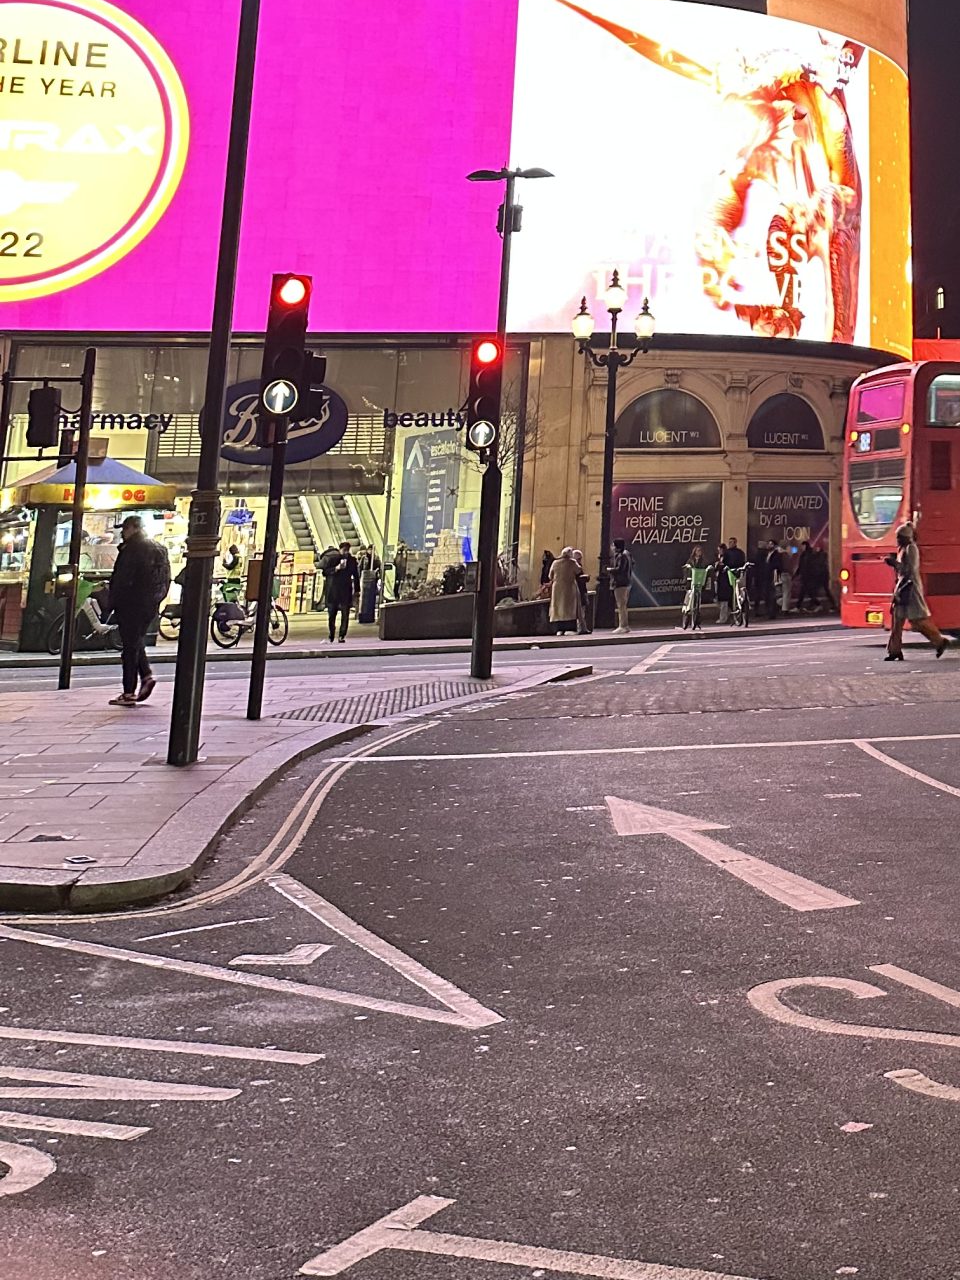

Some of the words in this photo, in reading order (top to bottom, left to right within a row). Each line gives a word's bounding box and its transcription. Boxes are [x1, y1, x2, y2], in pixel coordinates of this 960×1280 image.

[41, 78, 117, 98] YEAR
[384, 408, 467, 431] beauty
[640, 430, 688, 443] LUCENT
[764, 432, 800, 444] LUCENT
[618, 497, 664, 512] PRIME
[754, 495, 823, 510] ILLUMINATED
[626, 513, 657, 528] retail
[661, 514, 703, 530] space
[760, 512, 773, 528] by
[774, 514, 788, 526] an
[632, 527, 710, 544] AVAILABLE
[784, 527, 811, 540] ICON
